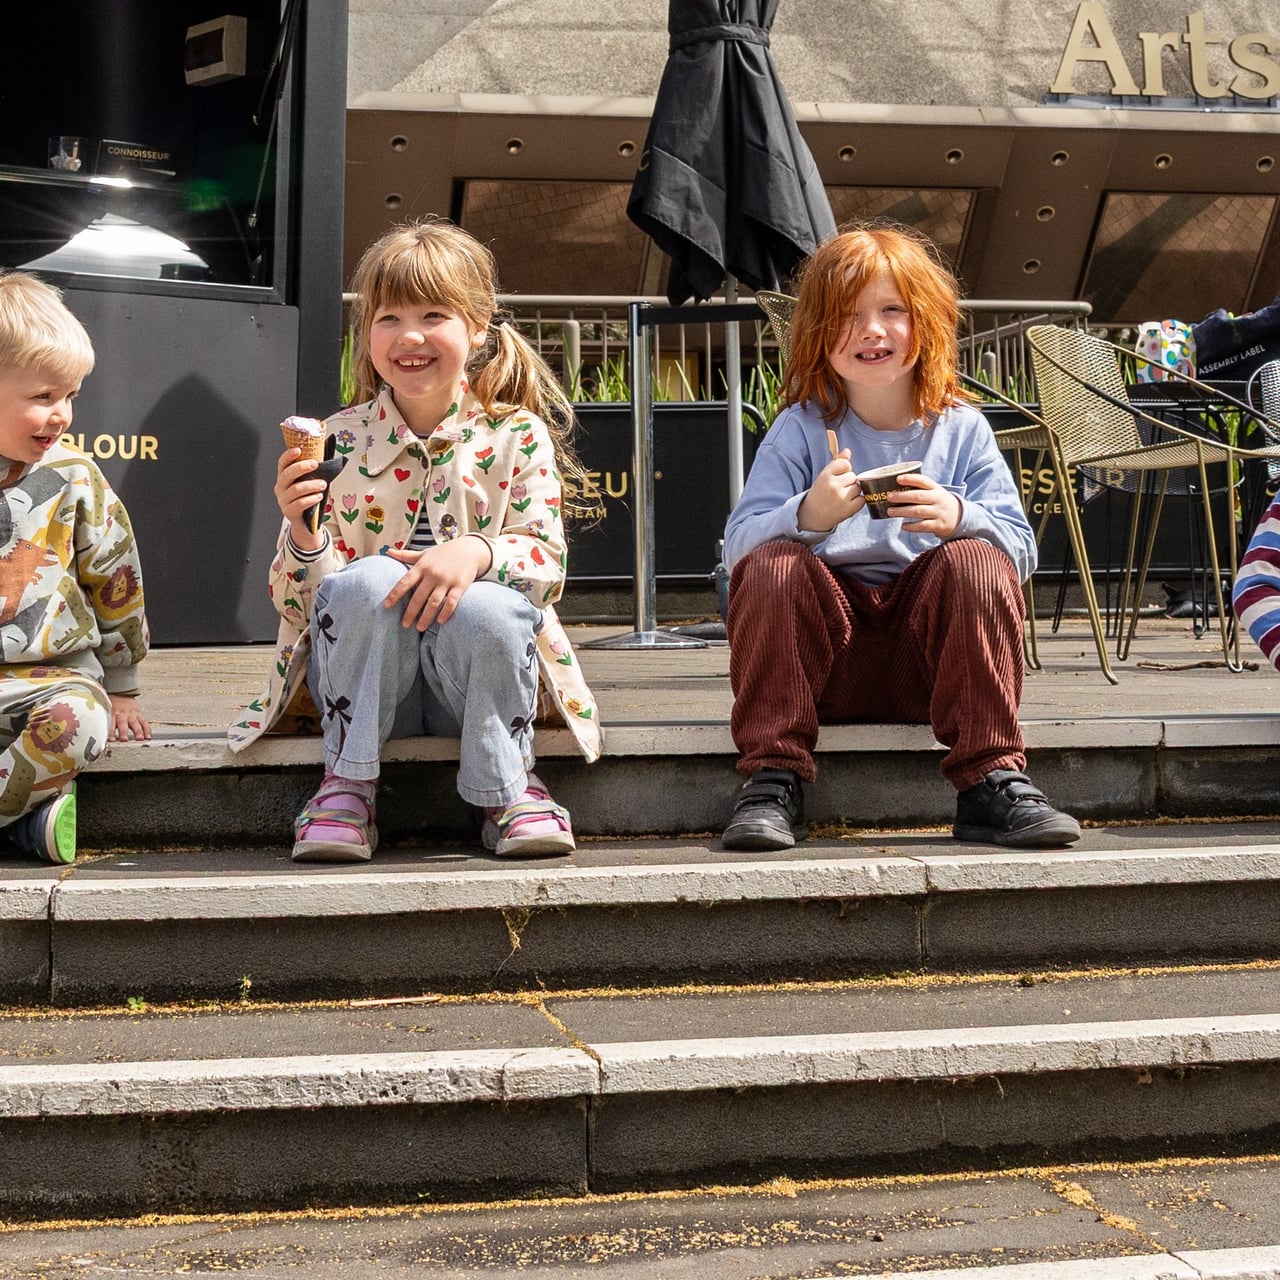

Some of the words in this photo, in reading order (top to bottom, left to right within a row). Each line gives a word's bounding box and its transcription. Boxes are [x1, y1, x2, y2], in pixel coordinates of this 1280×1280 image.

[107, 146, 170, 160] CONNOISSEUR
[1198, 354, 1239, 375] ASSEMBLY
[1240, 344, 1267, 360] LABEL
